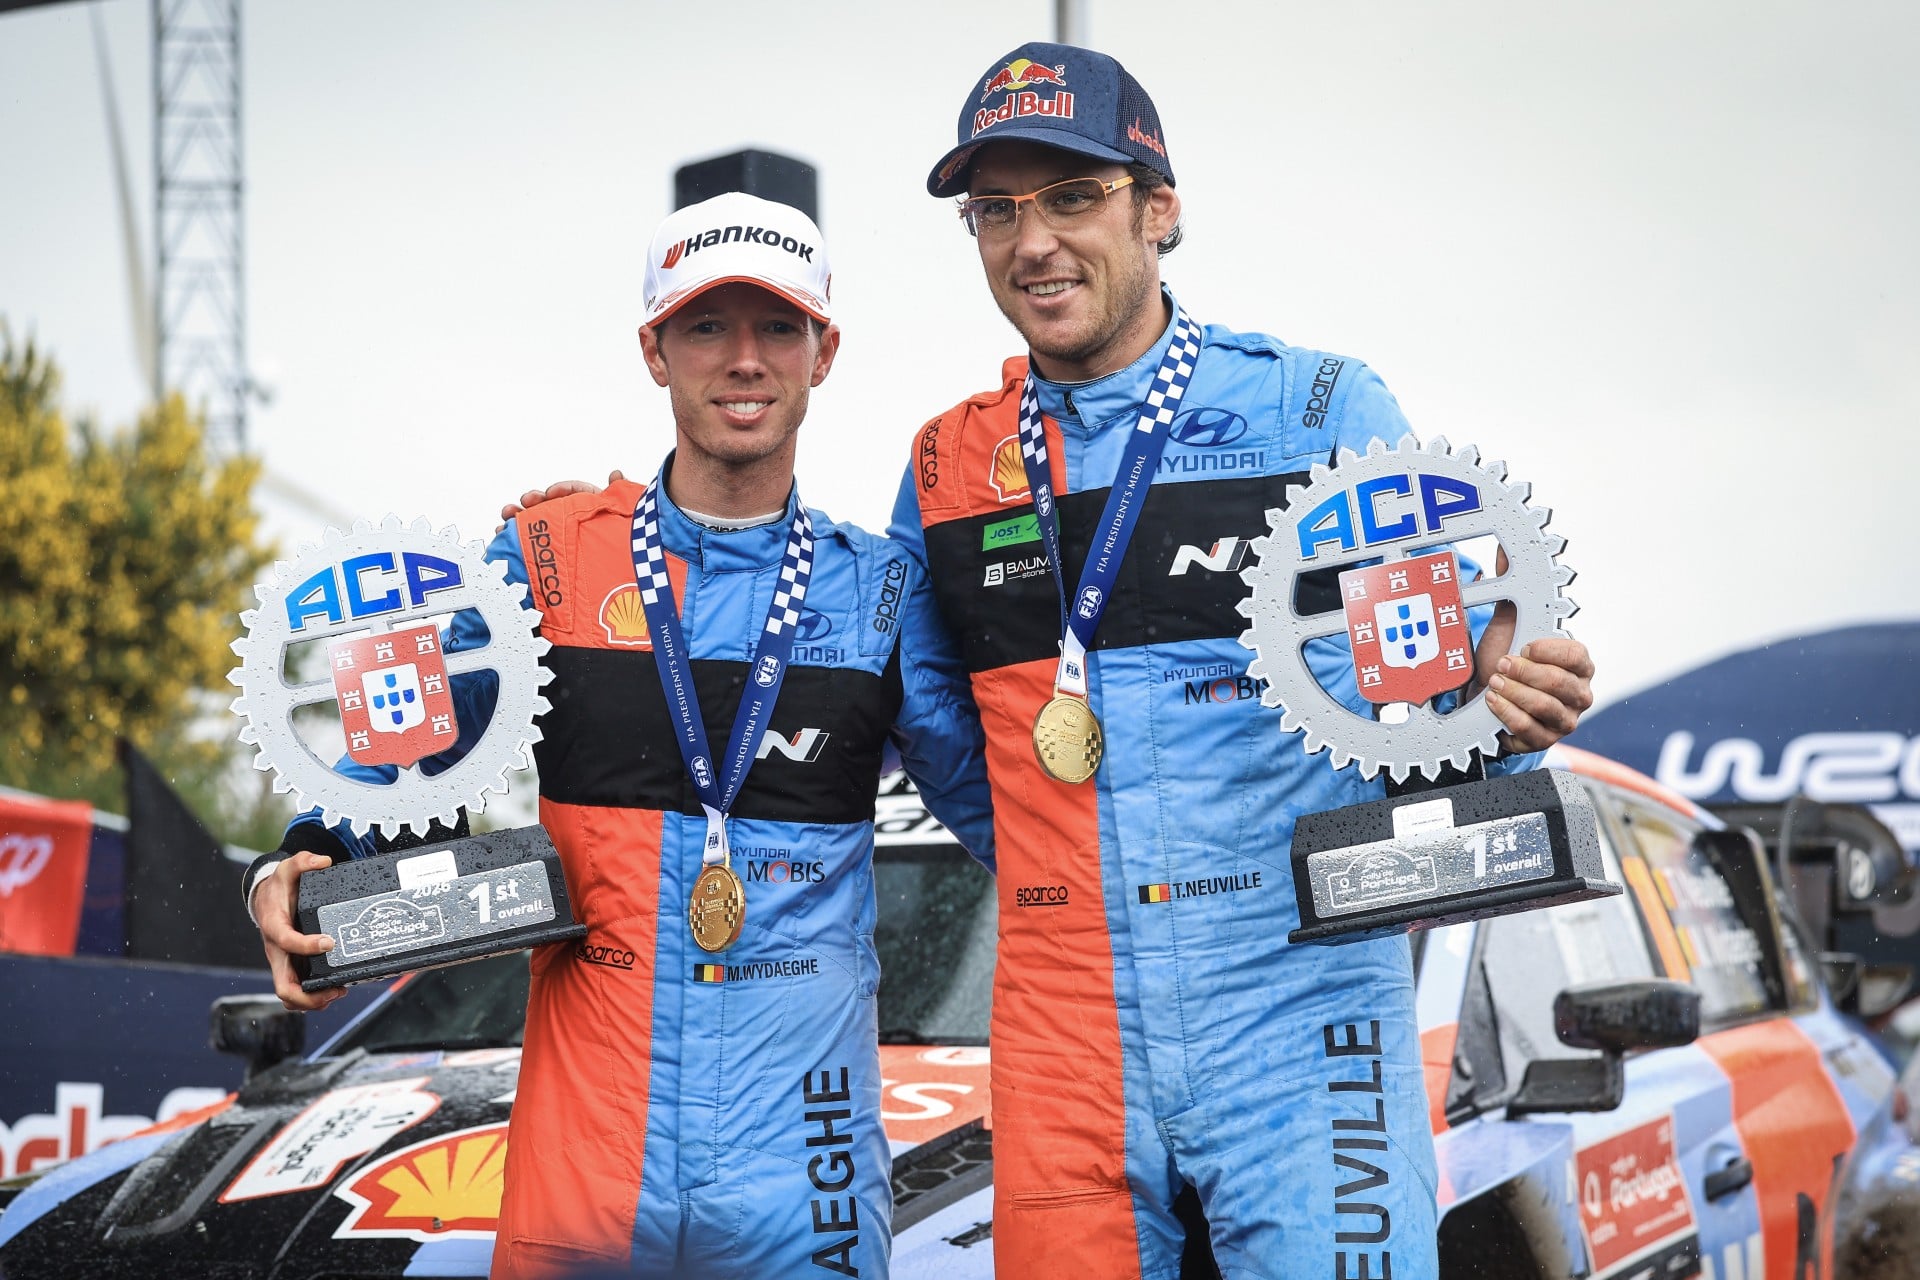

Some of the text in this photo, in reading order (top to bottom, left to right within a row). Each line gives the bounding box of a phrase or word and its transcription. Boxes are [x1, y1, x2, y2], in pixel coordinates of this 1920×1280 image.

[972, 91, 1074, 138] Red Bull
[1302, 358, 1345, 430] sparco
[920, 418, 943, 493] sparco
[1037, 484, 1050, 515] FIA
[1096, 454, 1147, 573] FIA PRESIDENT'S MEDAL
[1297, 473, 1483, 560] ACP
[990, 525, 1020, 539] JOST
[528, 519, 562, 607] sparco
[285, 551, 465, 632] ACP
[873, 558, 907, 637] sparco
[1080, 589, 1100, 618] FIA
[660, 622, 696, 743] FIA PRESIDENT'S MEDAL
[757, 657, 778, 684] FIA
[1066, 664, 1080, 677] FIA
[1164, 664, 1234, 682] HYUNDAI
[750, 700, 762, 716] FIA
[731, 719, 757, 782] PRESIDENT'S
[693, 758, 710, 788] FIA
[708, 834, 719, 847] FIA
[730, 847, 790, 859] HYUNDAI
[1463, 829, 1518, 878] 1st
[747, 861, 826, 884] MOBIS
[1494, 853, 1542, 874] overall
[1173, 871, 1263, 899] T.NEUVILLE
[1360, 871, 1420, 890] Portugal
[467, 877, 520, 924] 1st
[498, 899, 543, 919] overall
[1016, 886, 1069, 908] sparco
[728, 958, 820, 981] M.WYDAEGHE
[1324, 1019, 1392, 1280] EUVILLE
[803, 1066, 860, 1280] AEGHE
